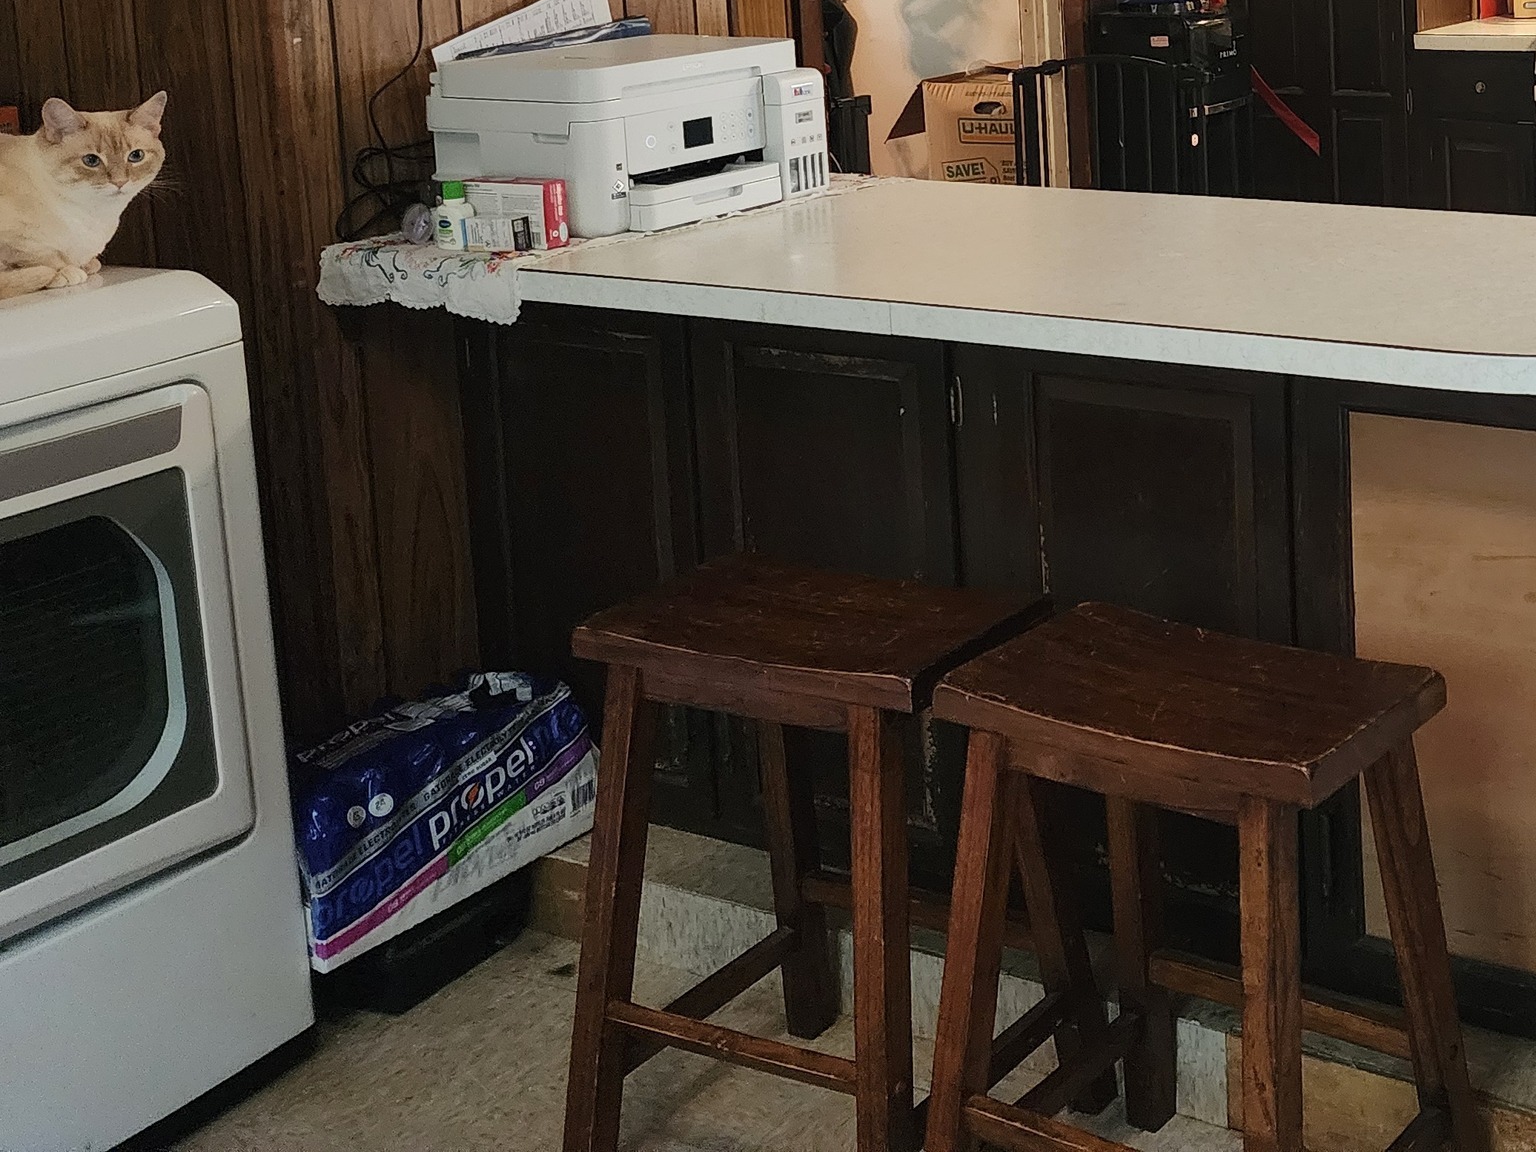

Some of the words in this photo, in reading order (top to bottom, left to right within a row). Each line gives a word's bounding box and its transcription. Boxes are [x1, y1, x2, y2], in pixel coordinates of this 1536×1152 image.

[1219, 49, 1238, 59] PRIMO
[946, 162, 986, 179] SAVE!
[428, 736, 535, 852] propel
